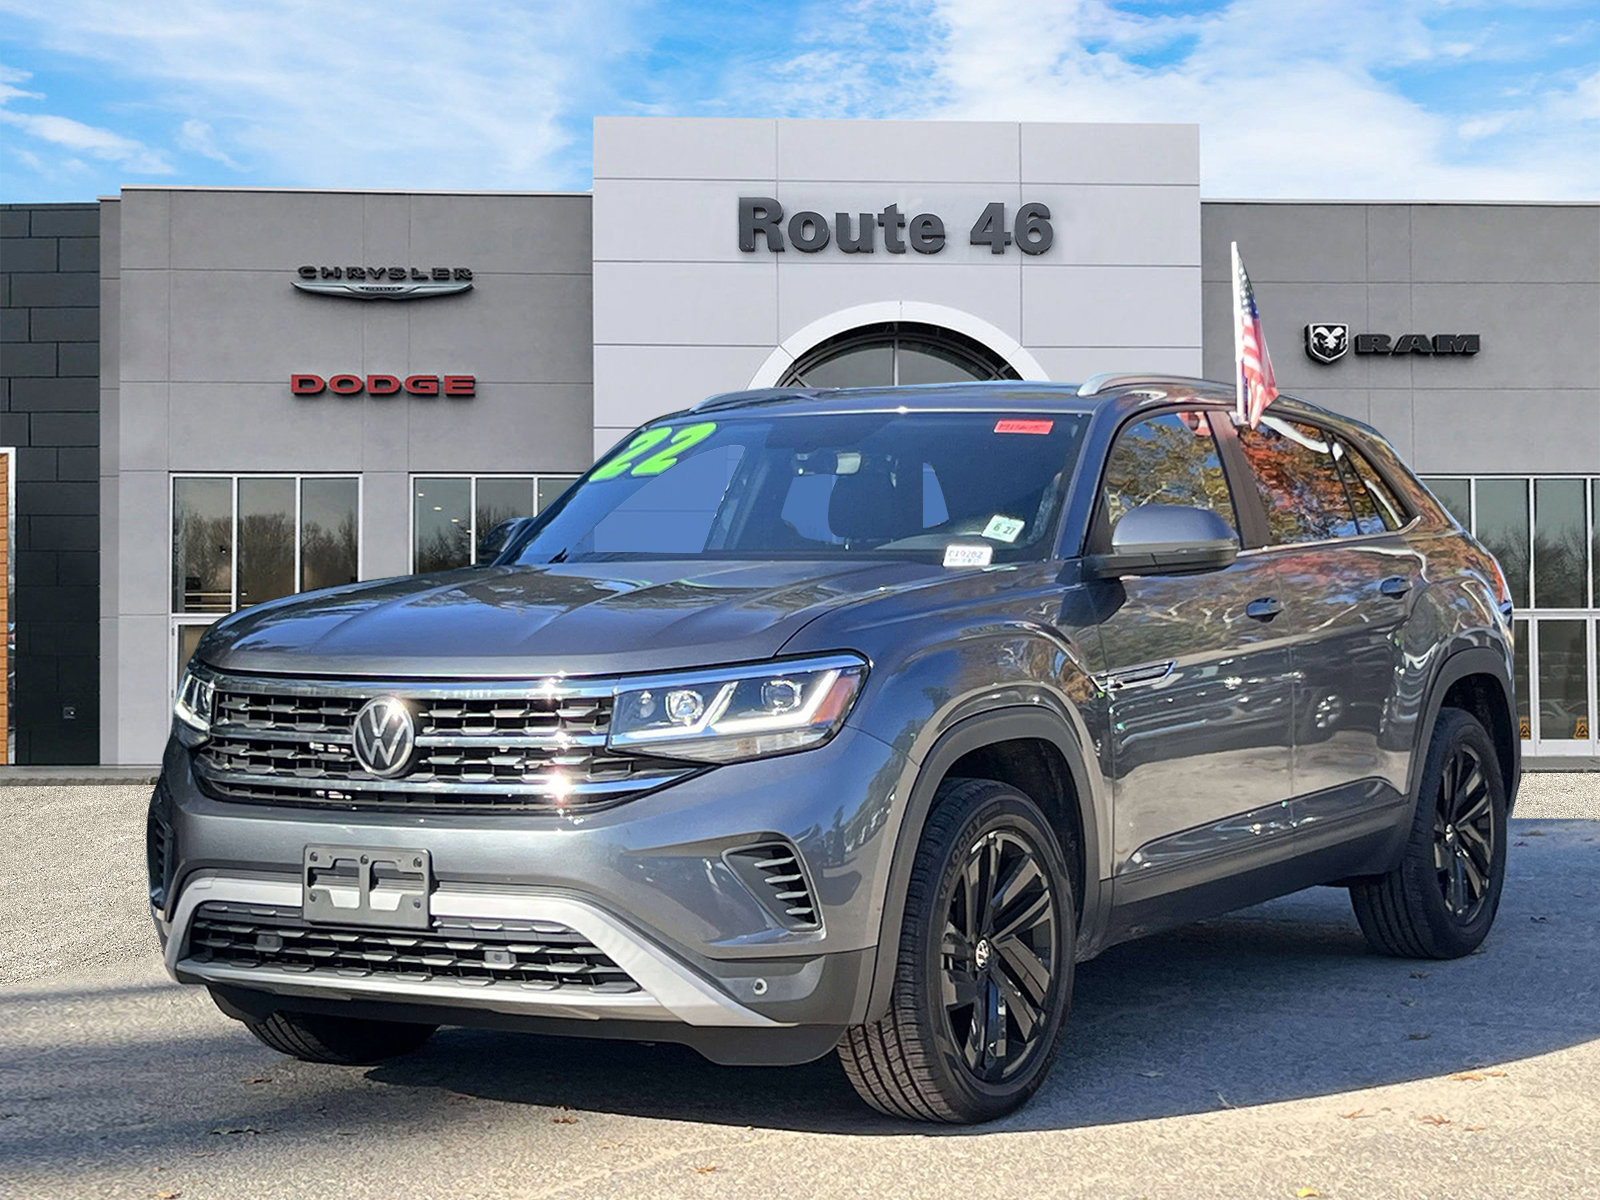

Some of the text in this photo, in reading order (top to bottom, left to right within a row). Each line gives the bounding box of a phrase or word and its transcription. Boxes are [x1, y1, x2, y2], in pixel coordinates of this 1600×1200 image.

[738, 197, 1055, 256] Route 46
[298, 266, 473, 280] CHRYSLER
[1354, 334, 1480, 355] RAM
[291, 374, 475, 396] DODGE
[588, 421, 718, 483] 22
